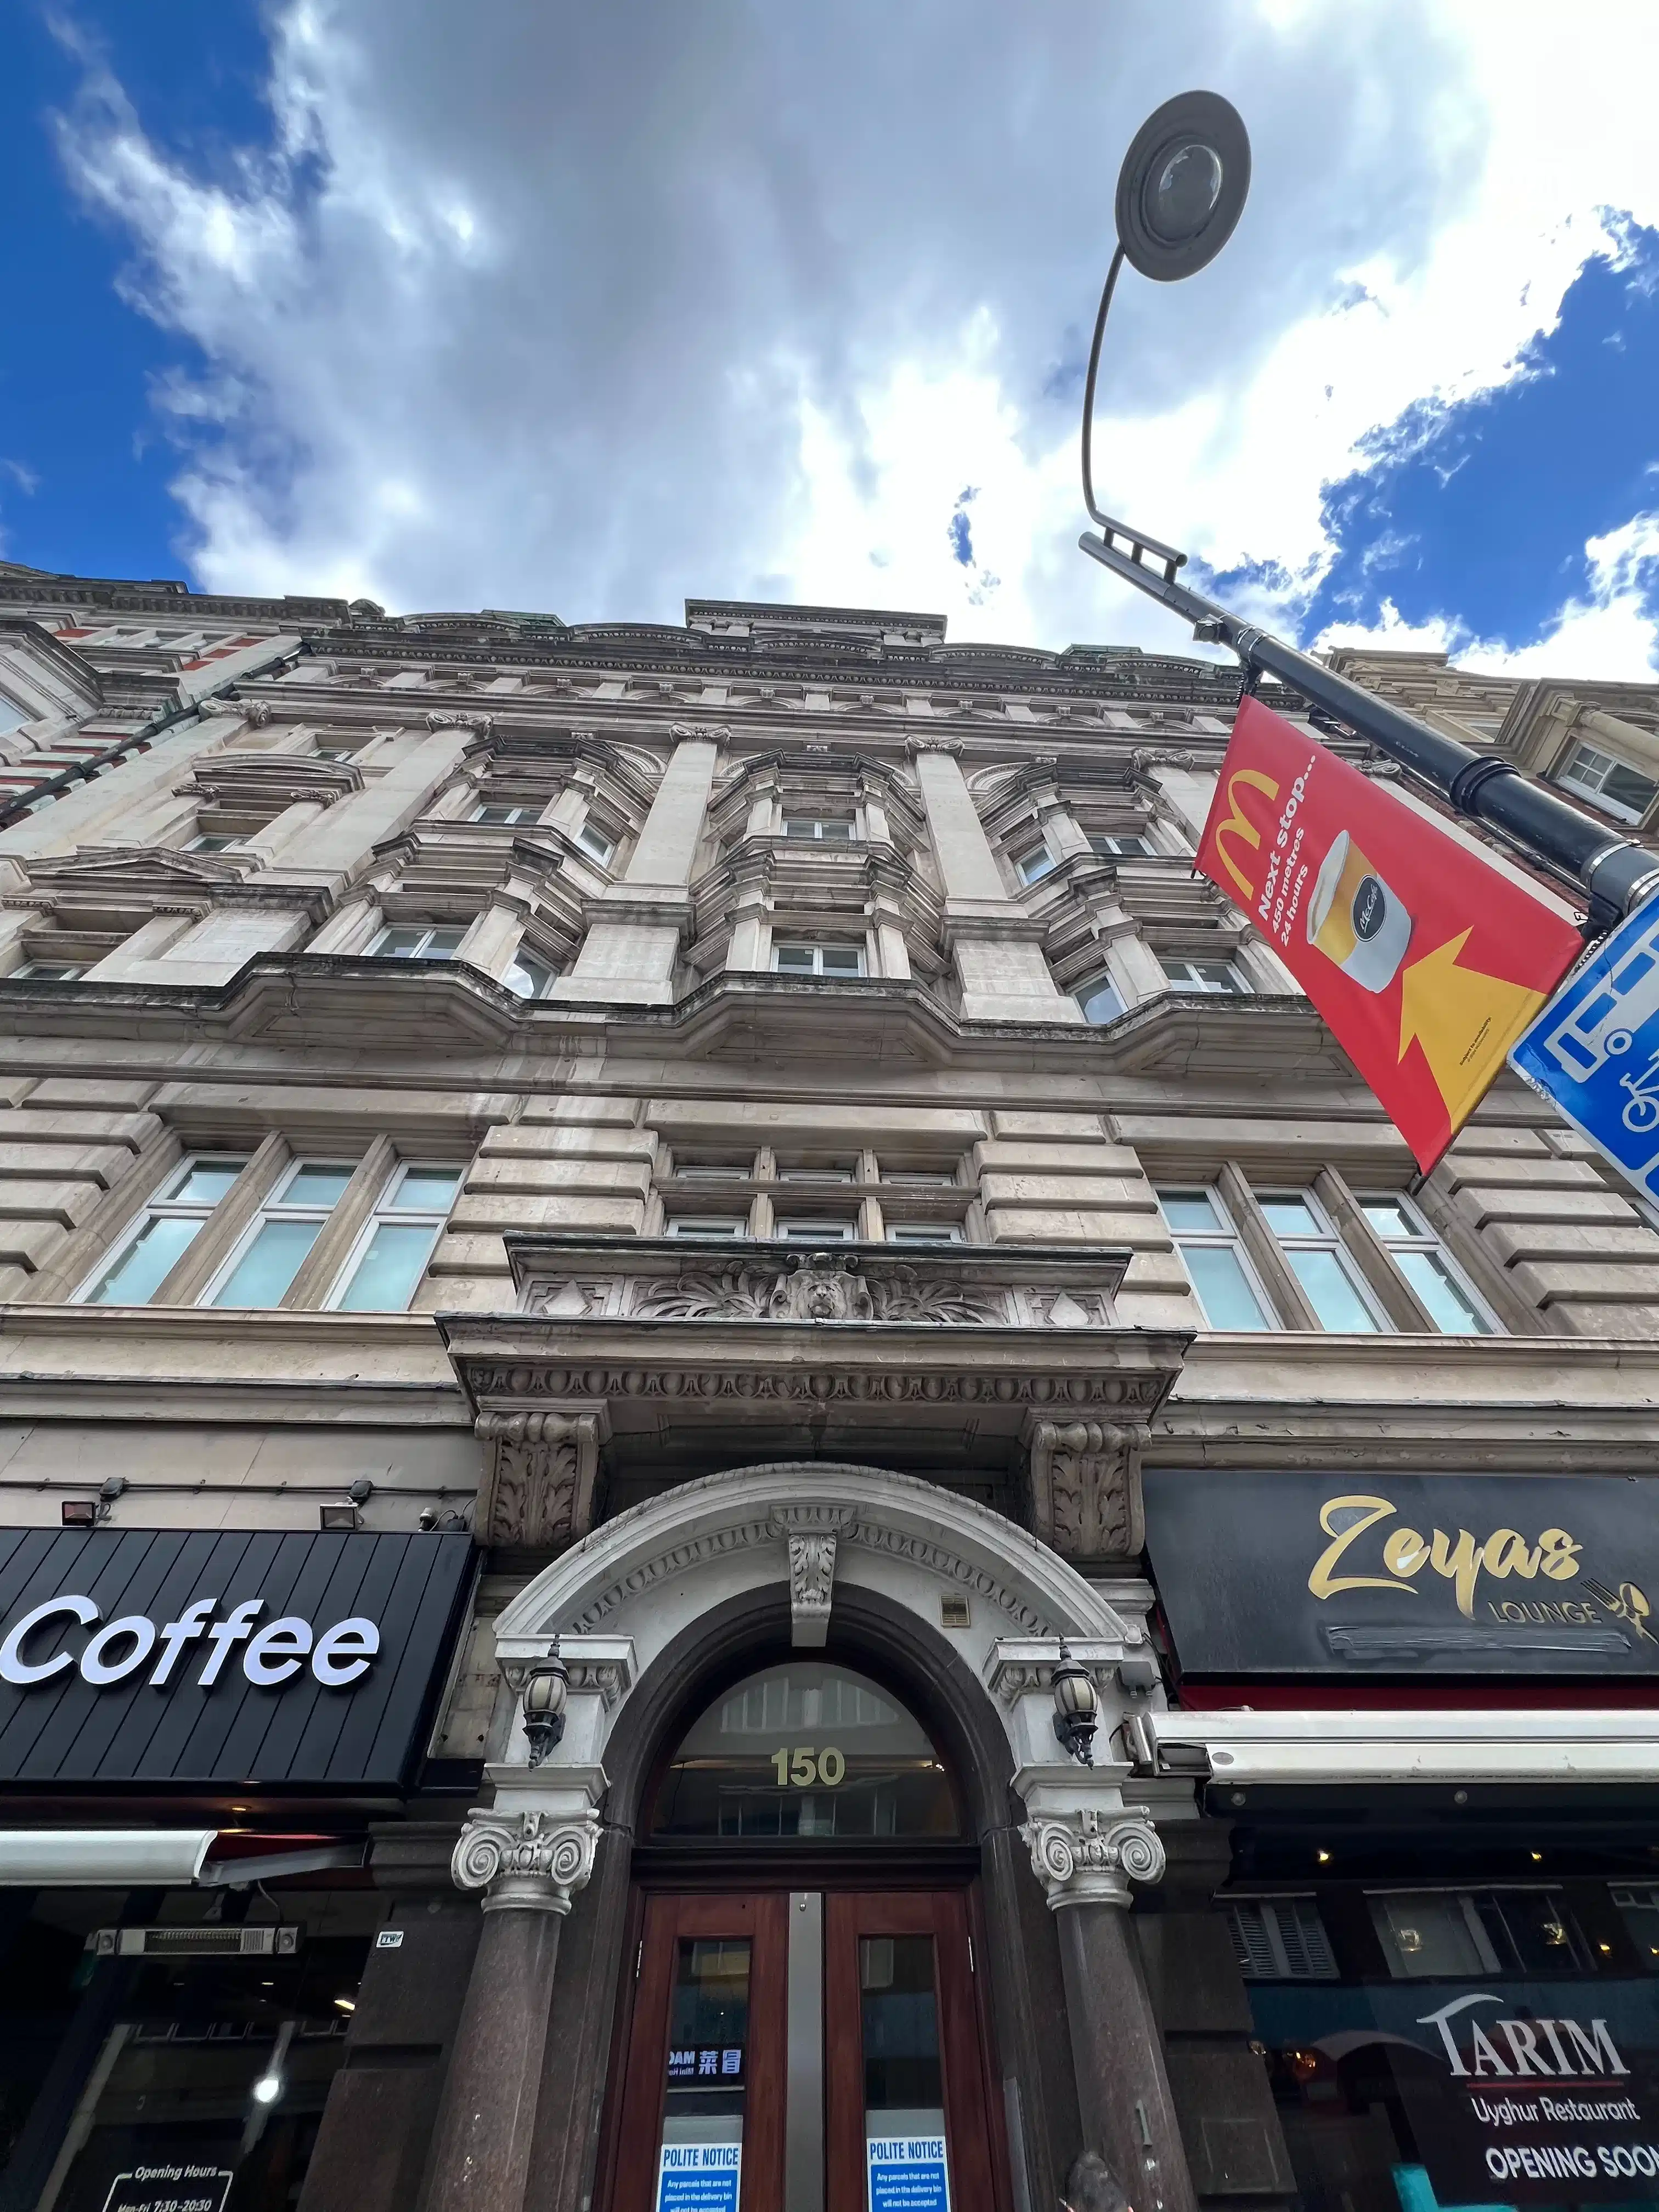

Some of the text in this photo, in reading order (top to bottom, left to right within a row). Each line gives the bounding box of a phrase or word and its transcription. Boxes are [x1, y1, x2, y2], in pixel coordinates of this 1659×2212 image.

[1258, 755, 1316, 921] Next stop...
[1272, 827, 1305, 933] 450 metres
[1281, 864, 1308, 947] 24 hours
[1308, 1494, 1583, 1620] Zeyas
[1487, 1600, 1603, 1624] LOUNGE
[0, 1594, 381, 1686] Coffee
[771, 1747, 845, 1786] 150
[1417, 1993, 1631, 2076] TARIM
[1471, 2096, 1641, 2127] Uyghur Restaurant
[663, 2147, 738, 2167] POLITE NOTICE
[870, 2141, 944, 2160] POLITE NOTICE
[1486, 2146, 1597, 2179] OPENING
[135, 2164, 218, 2181] Opening Hours
[667, 2180, 679, 2190] Any
[679, 2180, 699, 2190] parcels
[700, 2180, 712, 2188] that
[877, 2172, 888, 2182] Any
[888, 2173, 909, 2182] parcels
[909, 2171, 920, 2180] that
[664, 2193, 685, 2203] placed
[691, 2192, 701, 2200] the
[701, 2192, 723, 2201] delivery
[723, 2191, 732, 2200] bin
[876, 2186, 895, 2196] placed
[895, 2185, 901, 2193] in
[911, 2185, 933, 2194] delivery
[933, 2184, 942, 2192] bin
[883, 2199, 892, 2208] will
[902, 2199, 911, 2207] be
[911, 2198, 937, 2208] accepted
